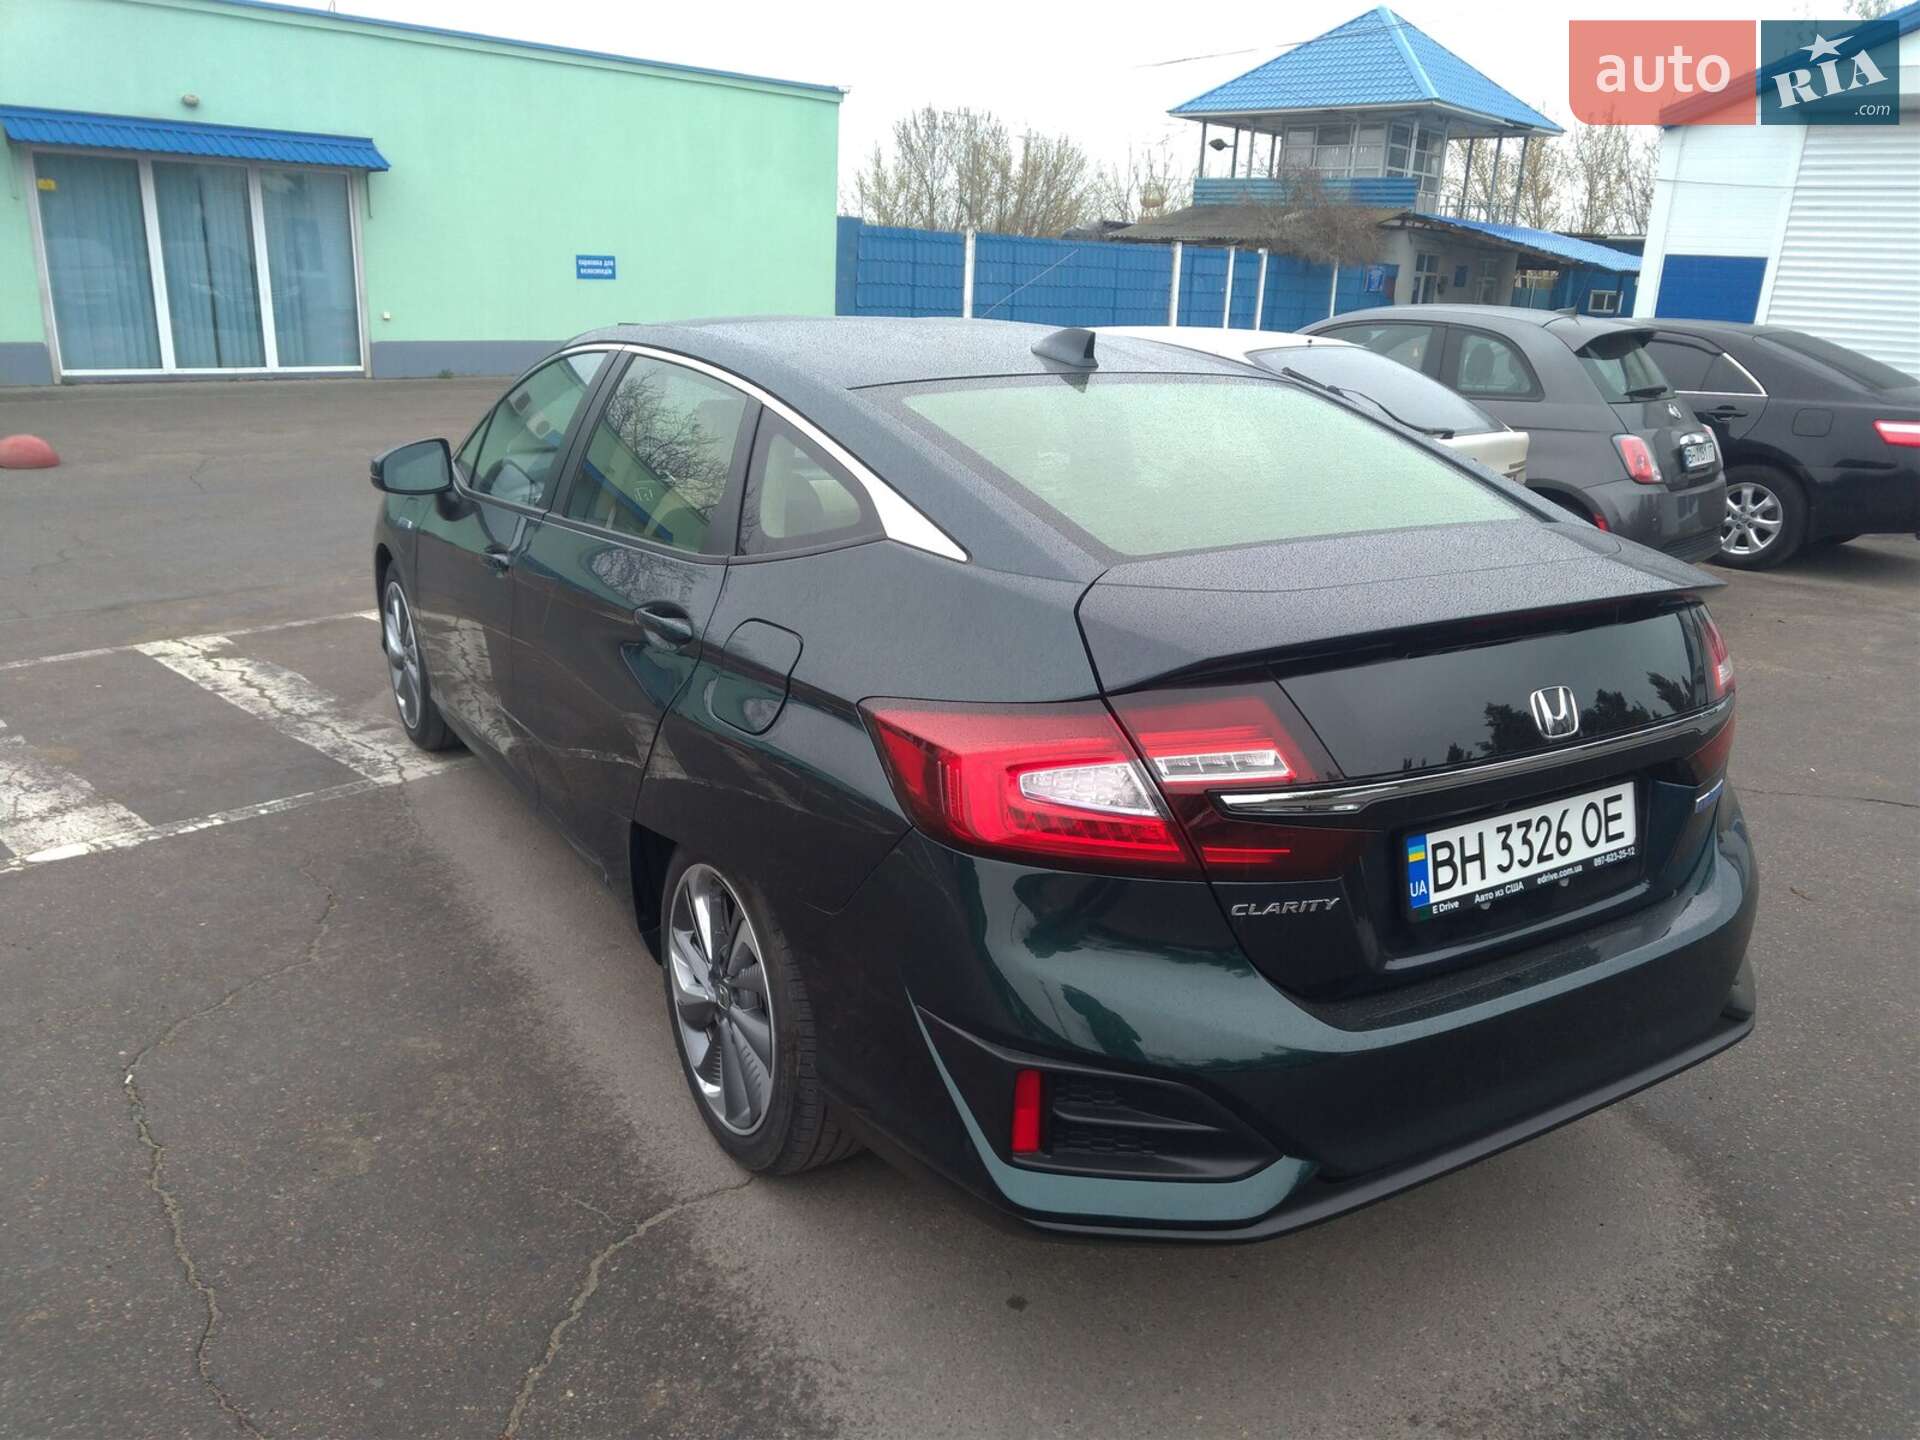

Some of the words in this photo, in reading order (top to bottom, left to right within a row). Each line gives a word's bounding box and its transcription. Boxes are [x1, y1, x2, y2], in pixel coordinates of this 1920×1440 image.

[1431, 831, 1487, 893] BH
[1496, 808, 1573, 873] 3326
[1581, 794, 1625, 849] OE
[1537, 864, 1583, 885] edrive.com.ua
[1410, 880, 1428, 897] UA
[1474, 892, 1494, 903] Авто
[1494, 888, 1504, 898] из
[1505, 881, 1525, 894] США
[1231, 897, 1340, 916] CLARITY
[1432, 905, 1439, 914] E
[1439, 900, 1460, 912] Drive
